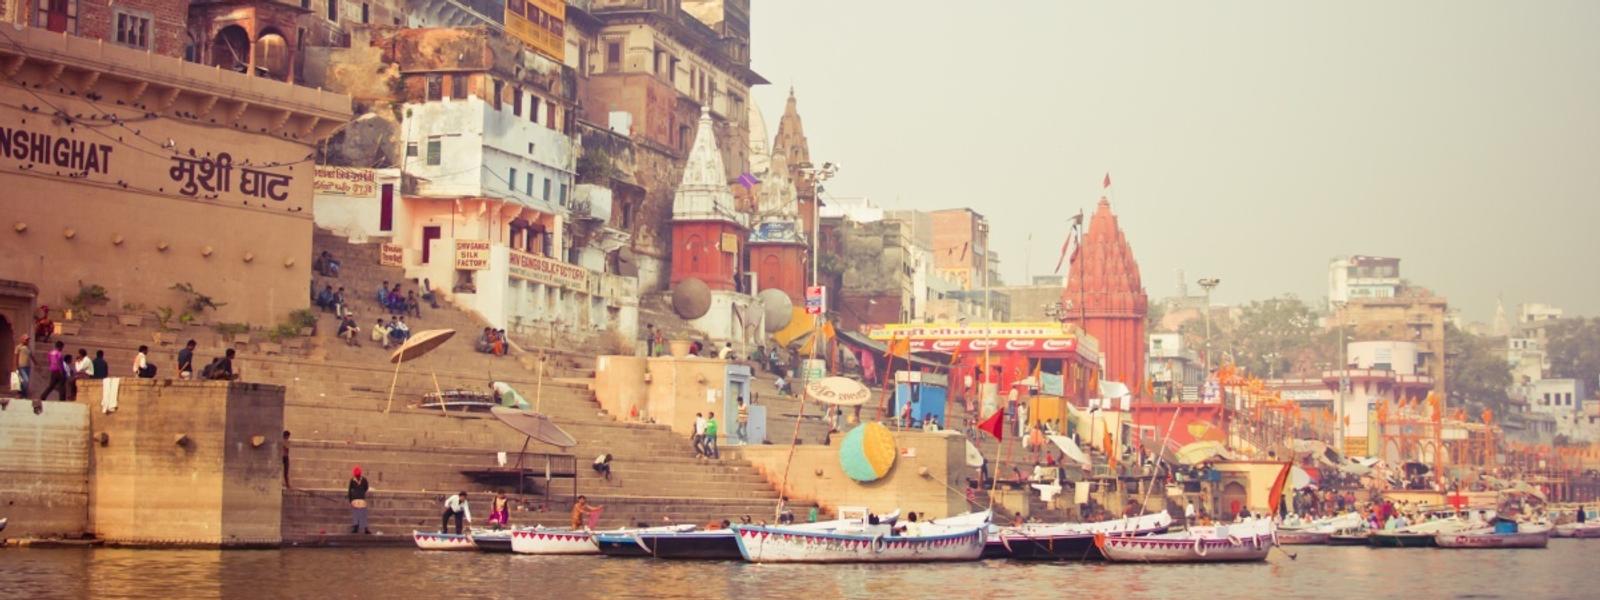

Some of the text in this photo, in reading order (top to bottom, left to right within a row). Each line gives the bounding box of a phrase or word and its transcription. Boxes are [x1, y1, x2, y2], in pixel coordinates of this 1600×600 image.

[240, 168, 293, 201] घाट
[461, 251, 478, 259] SILK
[457, 259, 487, 267] FACTORY
